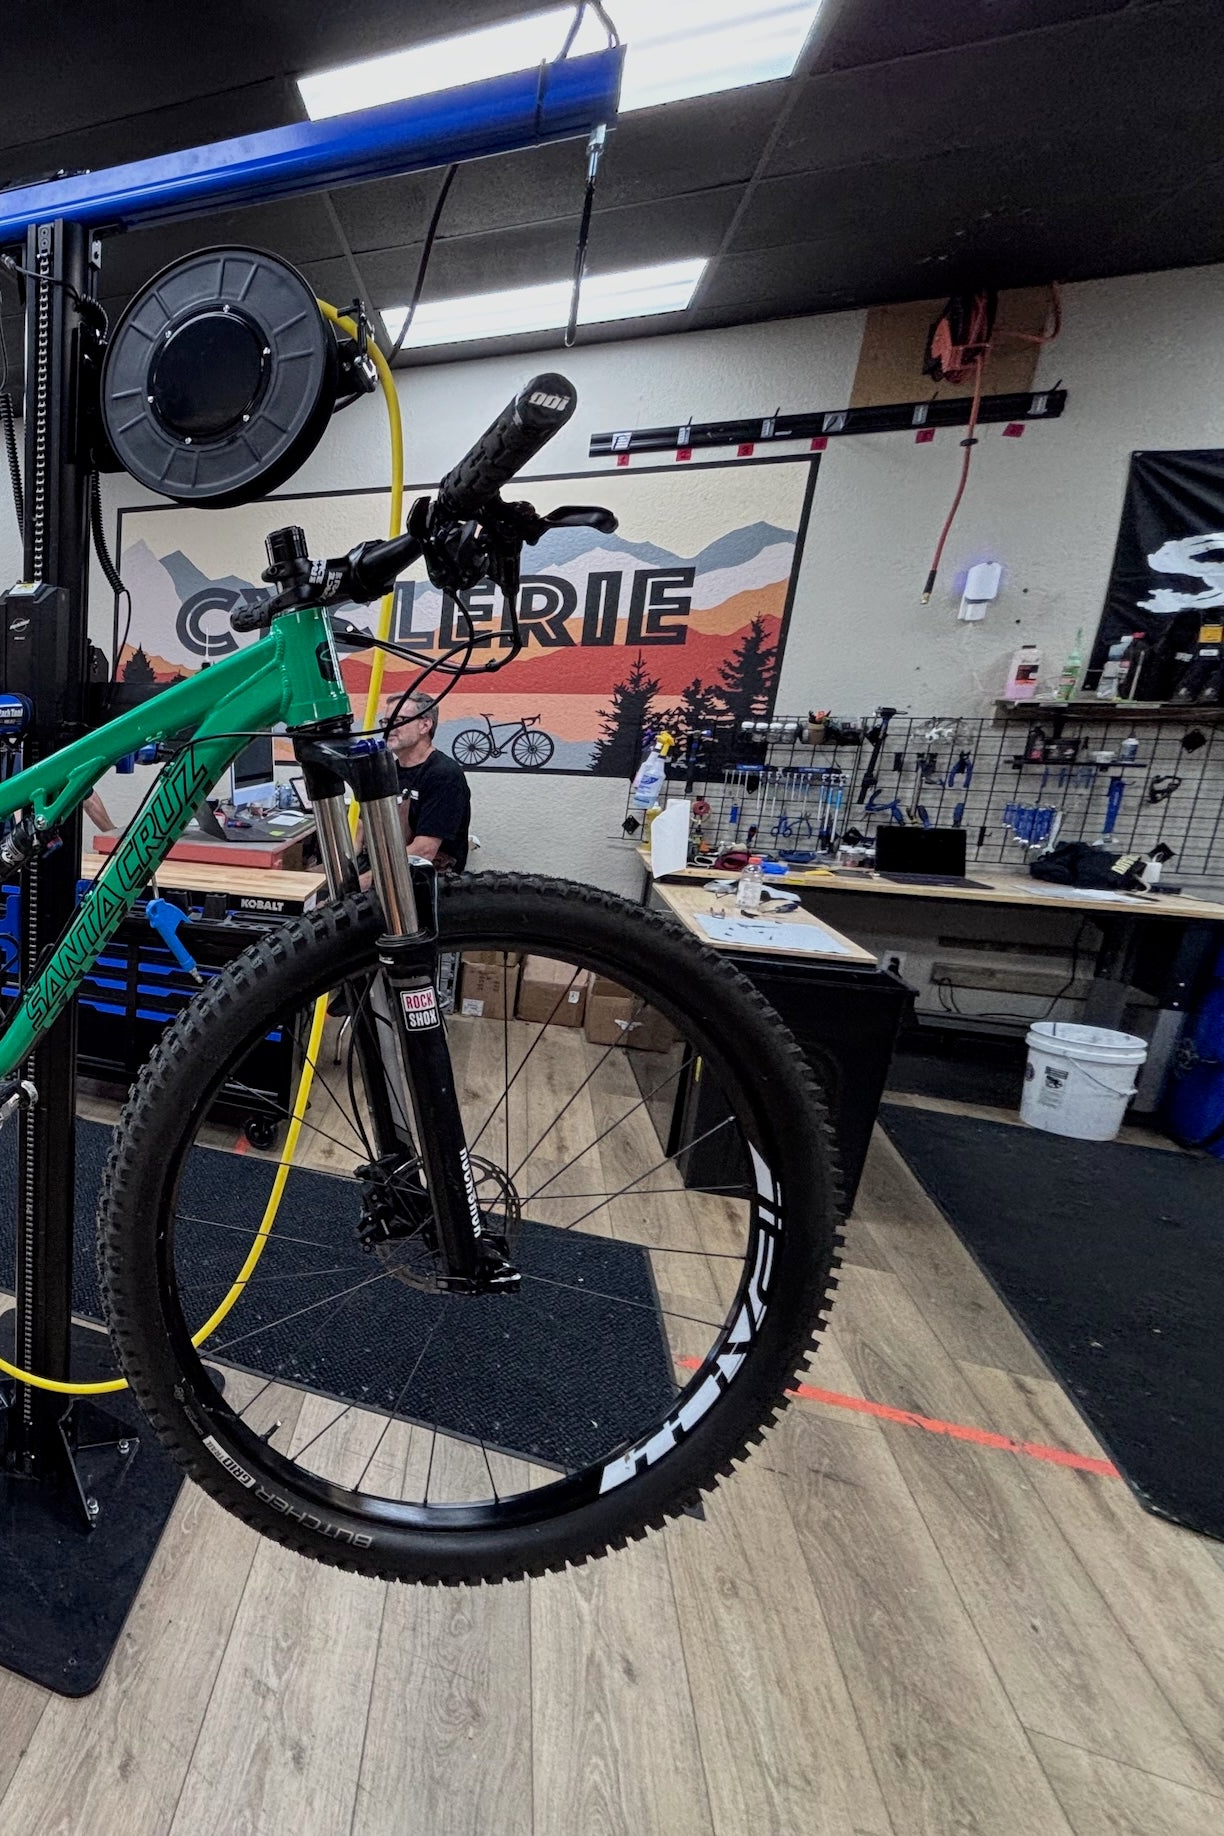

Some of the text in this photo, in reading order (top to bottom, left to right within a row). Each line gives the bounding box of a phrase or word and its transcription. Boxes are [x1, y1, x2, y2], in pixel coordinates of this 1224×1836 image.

[175, 566, 695, 657] CLERIE
[26, 746, 208, 1024] SANTA CRUZ
[240, 898, 284, 912] KOBALT
[405, 995, 434, 1010] ROCK
[408, 1008, 437, 1029] SHOX
[224, 1457, 253, 1485] GRID
[254, 1485, 374, 1549] BUTCHER
